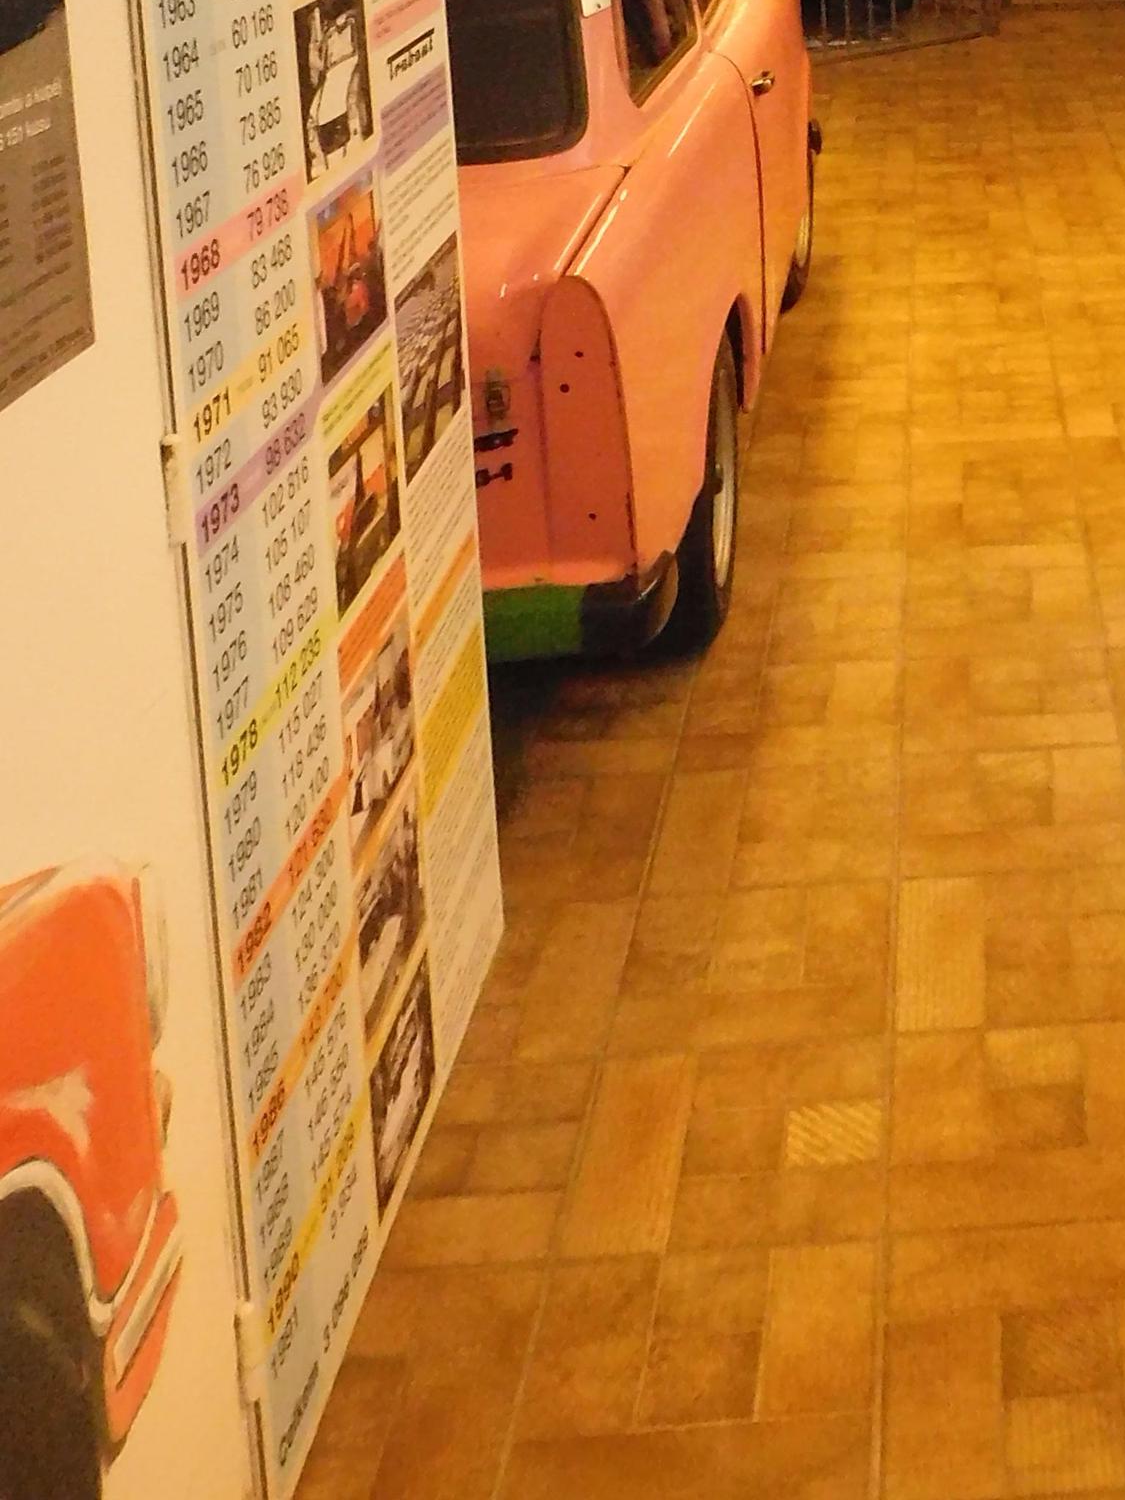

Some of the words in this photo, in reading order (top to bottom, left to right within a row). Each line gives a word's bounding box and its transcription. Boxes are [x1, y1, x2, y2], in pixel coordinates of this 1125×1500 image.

[162, 36, 200, 83] 1964
[231, 15, 249, 49] 60
[251, 3, 274, 40] 166
[167, 88, 204, 136] 1965
[235, 63, 252, 98] 70
[171, 140, 208, 189] 1966
[239, 111, 257, 146] 73
[175, 190, 211, 239] 1967
[243, 159, 260, 195] 76
[180, 238, 221, 292] 1968
[183, 290, 220, 343] 1969
[188, 340, 225, 394] 1970
[274, 278, 296, 321] 200
[192, 385, 232, 444] 1971
[195, 438, 232, 496] 1972
[201, 482, 241, 544] 1973
[205, 535, 239, 594] 1974
[208, 581, 244, 644] 1975
[212, 629, 248, 693] 1976
[216, 675, 250, 741] 1977
[221, 717, 258, 787] 1978
[224, 769, 258, 835] 1979
